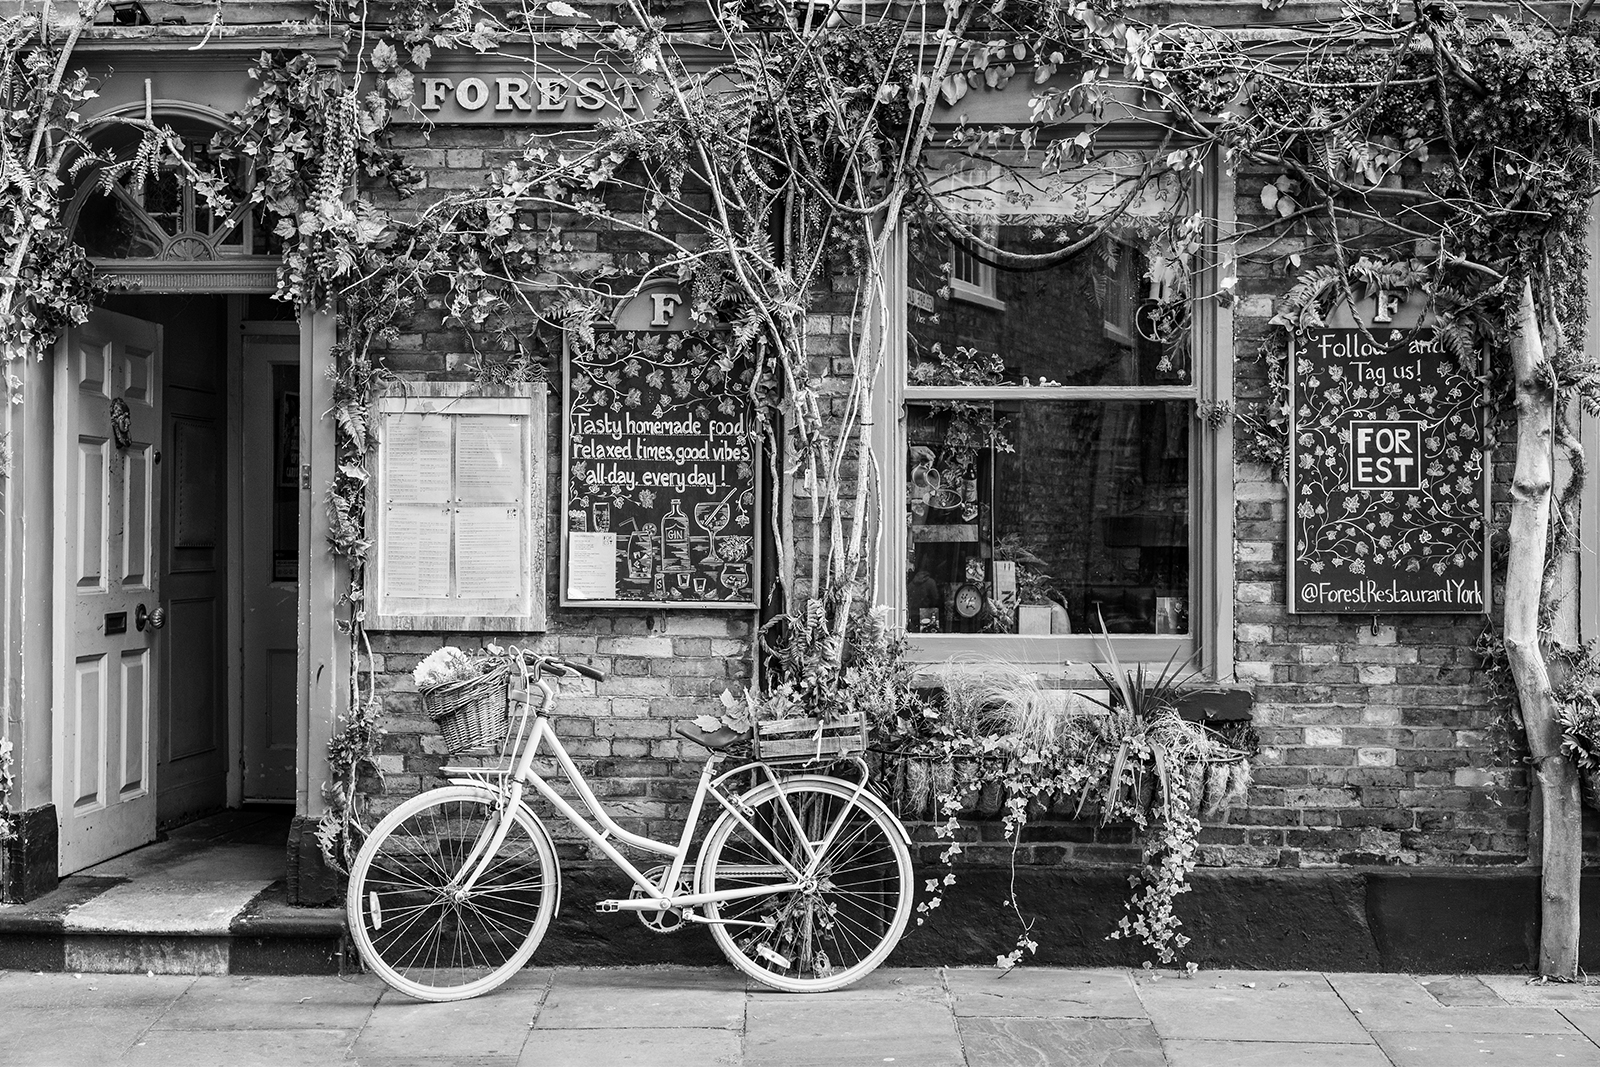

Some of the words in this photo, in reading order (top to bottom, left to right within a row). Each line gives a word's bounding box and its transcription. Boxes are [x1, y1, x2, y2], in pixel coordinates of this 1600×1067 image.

[421, 77, 646, 111] FOREST
[651, 293, 683, 326] F
[1373, 289, 1406, 322] F
[1349, 360, 1385, 386] Tag
[1393, 359, 1421, 381] us!
[572, 412, 623, 440] Tasty
[626, 412, 701, 435] homemade
[709, 412, 745, 442] food
[573, 438, 631, 459] relaxed
[712, 440, 750, 461] vibes
[1357, 428, 1413, 453] FOR
[642, 471, 686, 493] every
[687, 464, 716, 494] day
[1357, 457, 1414, 483] EST
[668, 530, 683, 540] GIN
[656, 580, 662, 589] S
[1302, 579, 1483, 604] @ForestRestaurantYork
